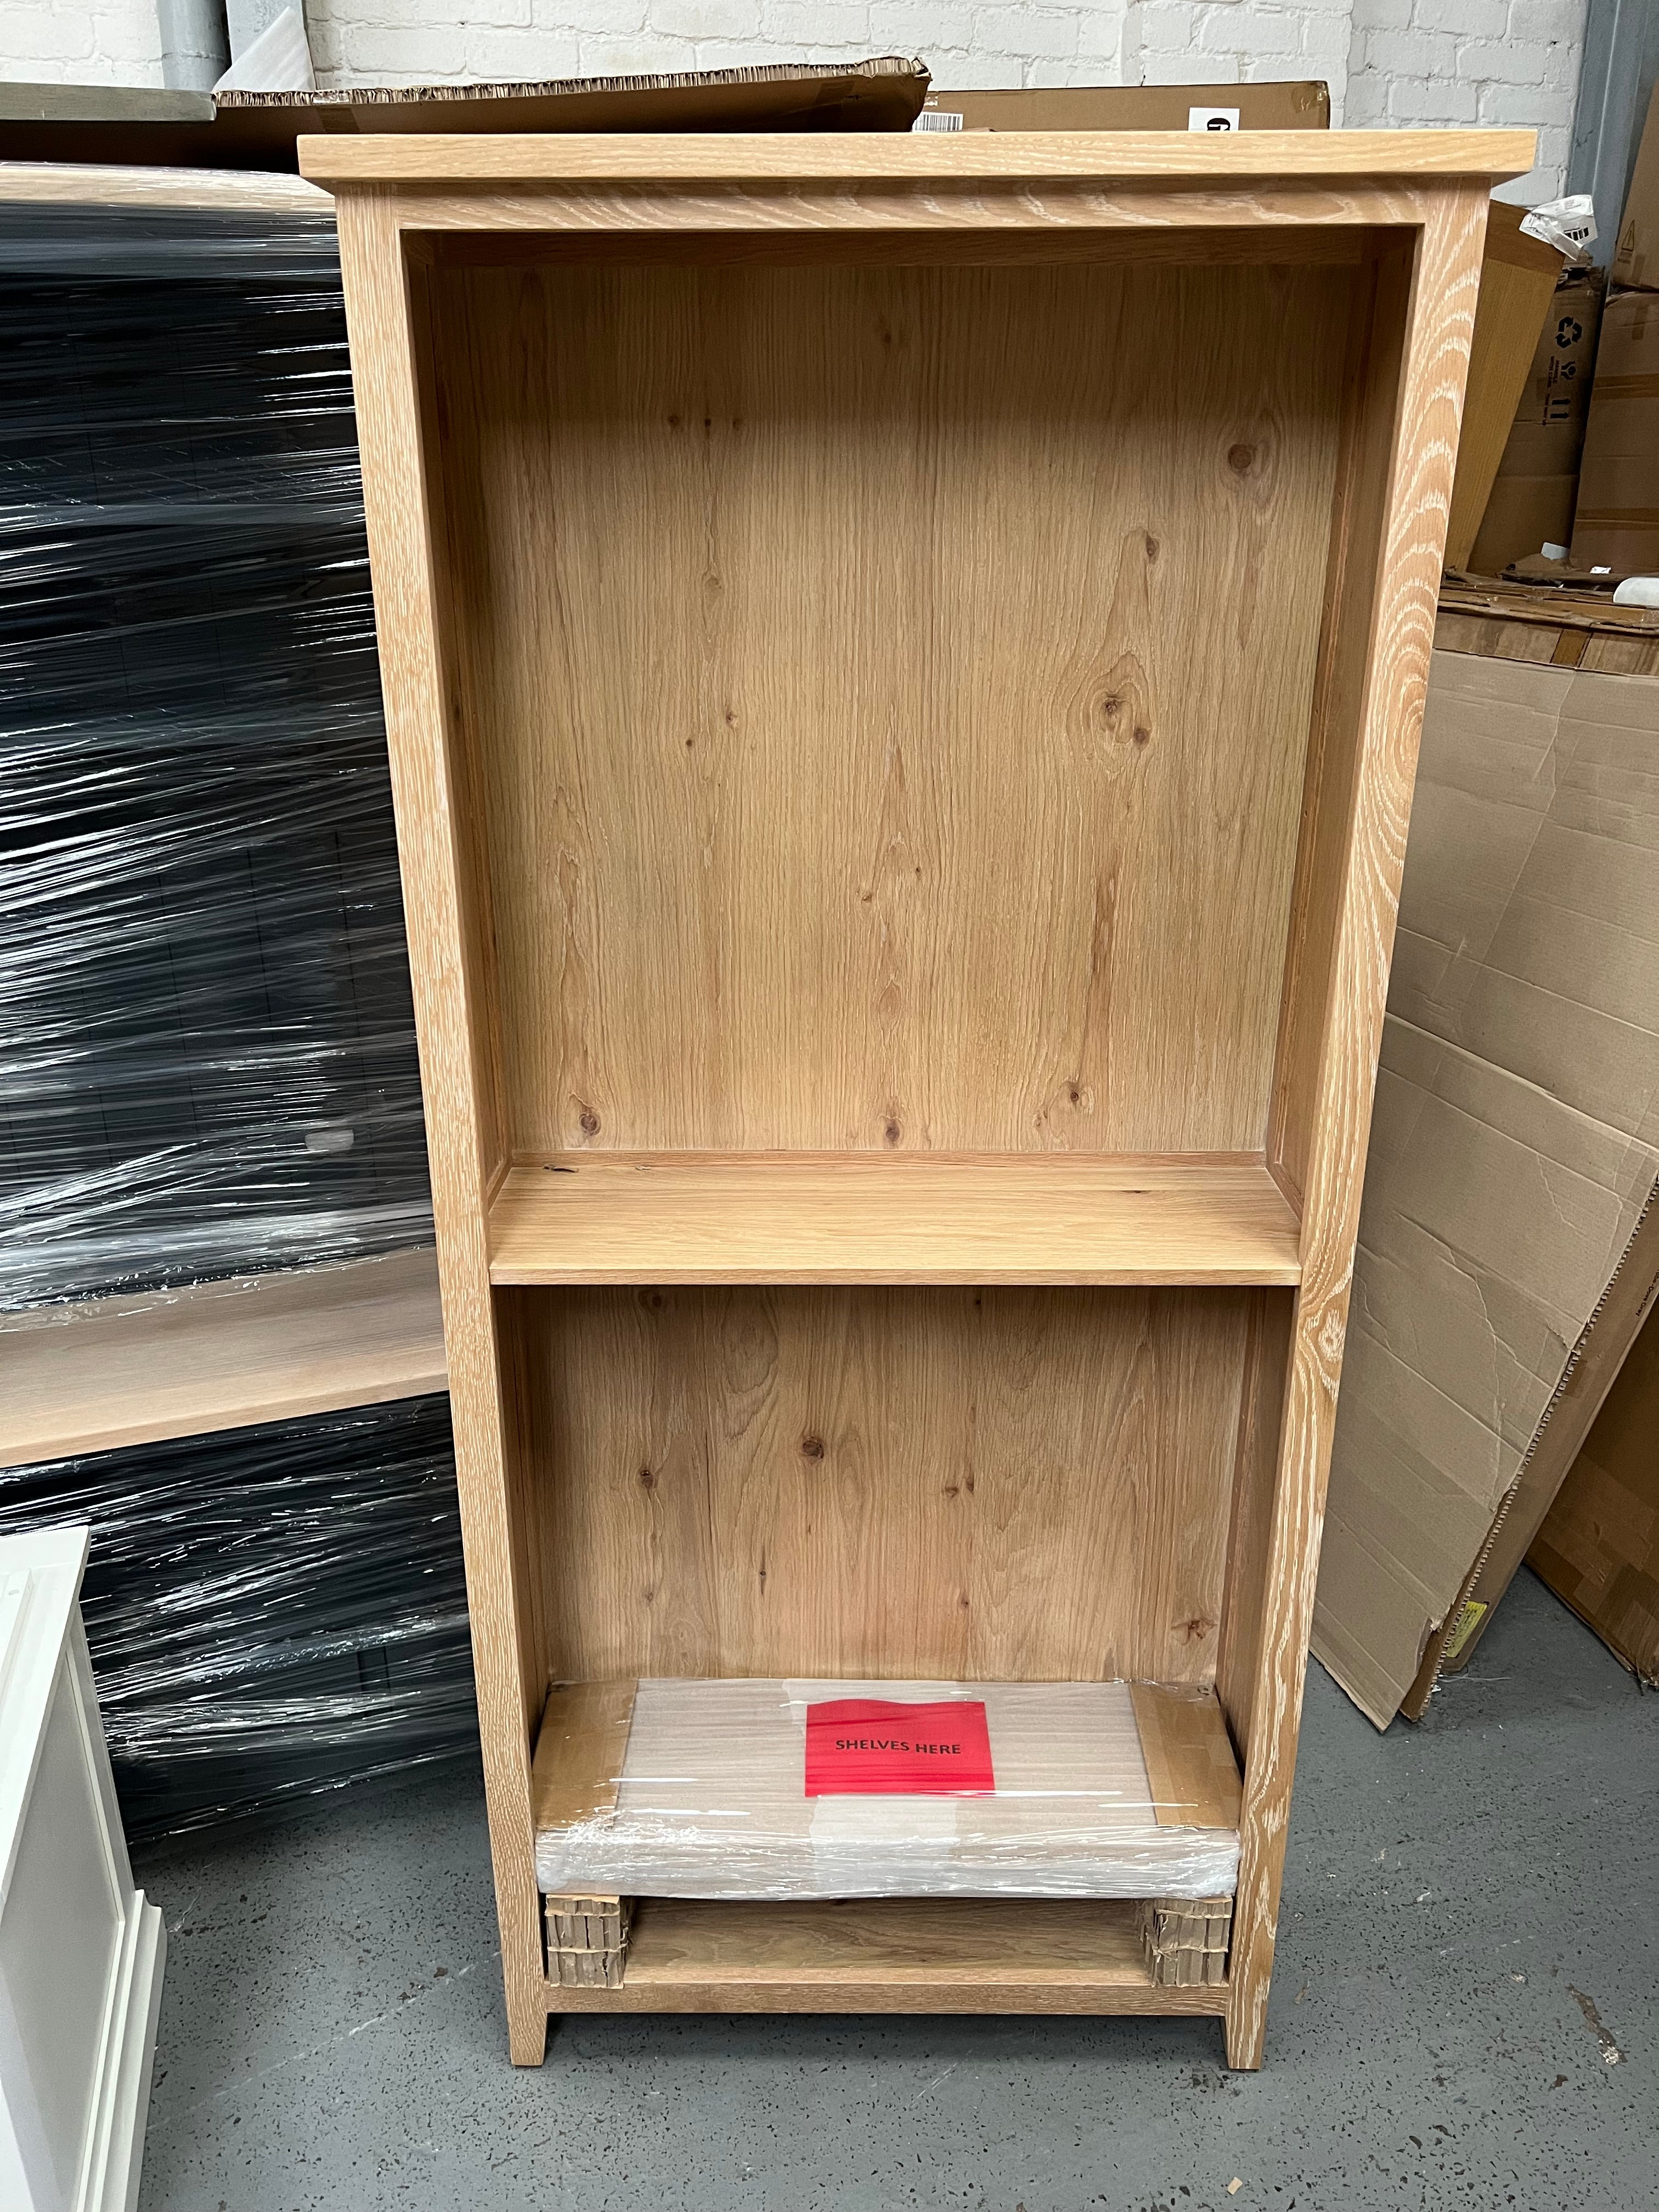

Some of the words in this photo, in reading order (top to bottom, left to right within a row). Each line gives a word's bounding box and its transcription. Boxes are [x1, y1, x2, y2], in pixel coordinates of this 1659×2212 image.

[1635, 1302, 1646, 1316] Grey
[836, 1740, 909, 1751] SHELVES
[915, 1743, 961, 1754] HERE
